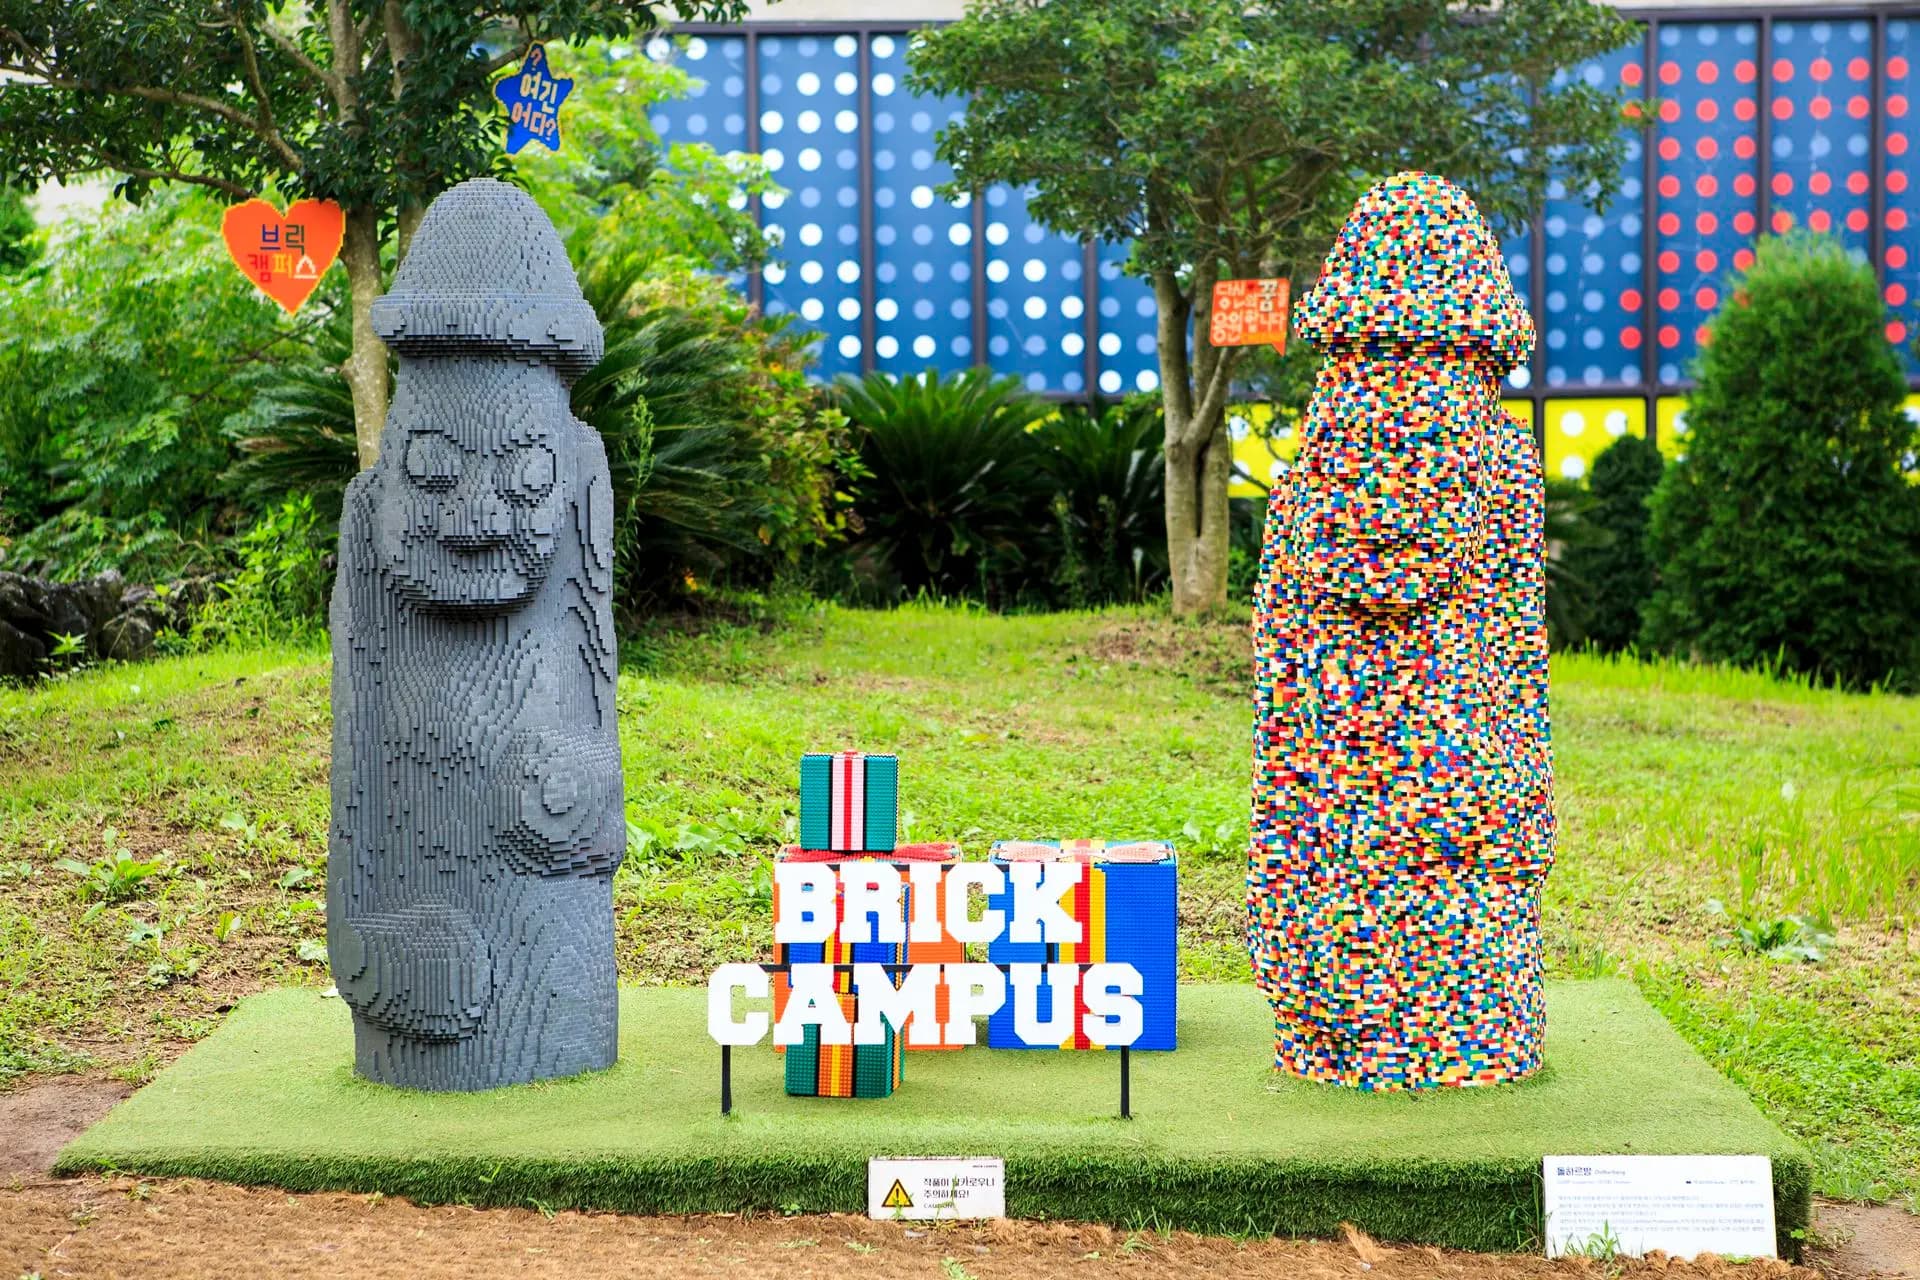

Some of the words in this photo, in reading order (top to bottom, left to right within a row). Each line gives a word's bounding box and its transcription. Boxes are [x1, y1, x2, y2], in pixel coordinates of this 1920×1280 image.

[530, 48, 542, 71] ?
[520, 72, 558, 113] 여긴
[511, 102, 556, 141] 어디?
[259, 223, 305, 256] 브릭
[248, 253, 318, 283] 캠퍼스
[774, 862, 1083, 943] BRICK
[707, 962, 1144, 1046] CAMPUS
[923, 1177, 949, 1187] 작품이
[1557, 1166, 1592, 1177] 돌하르방
